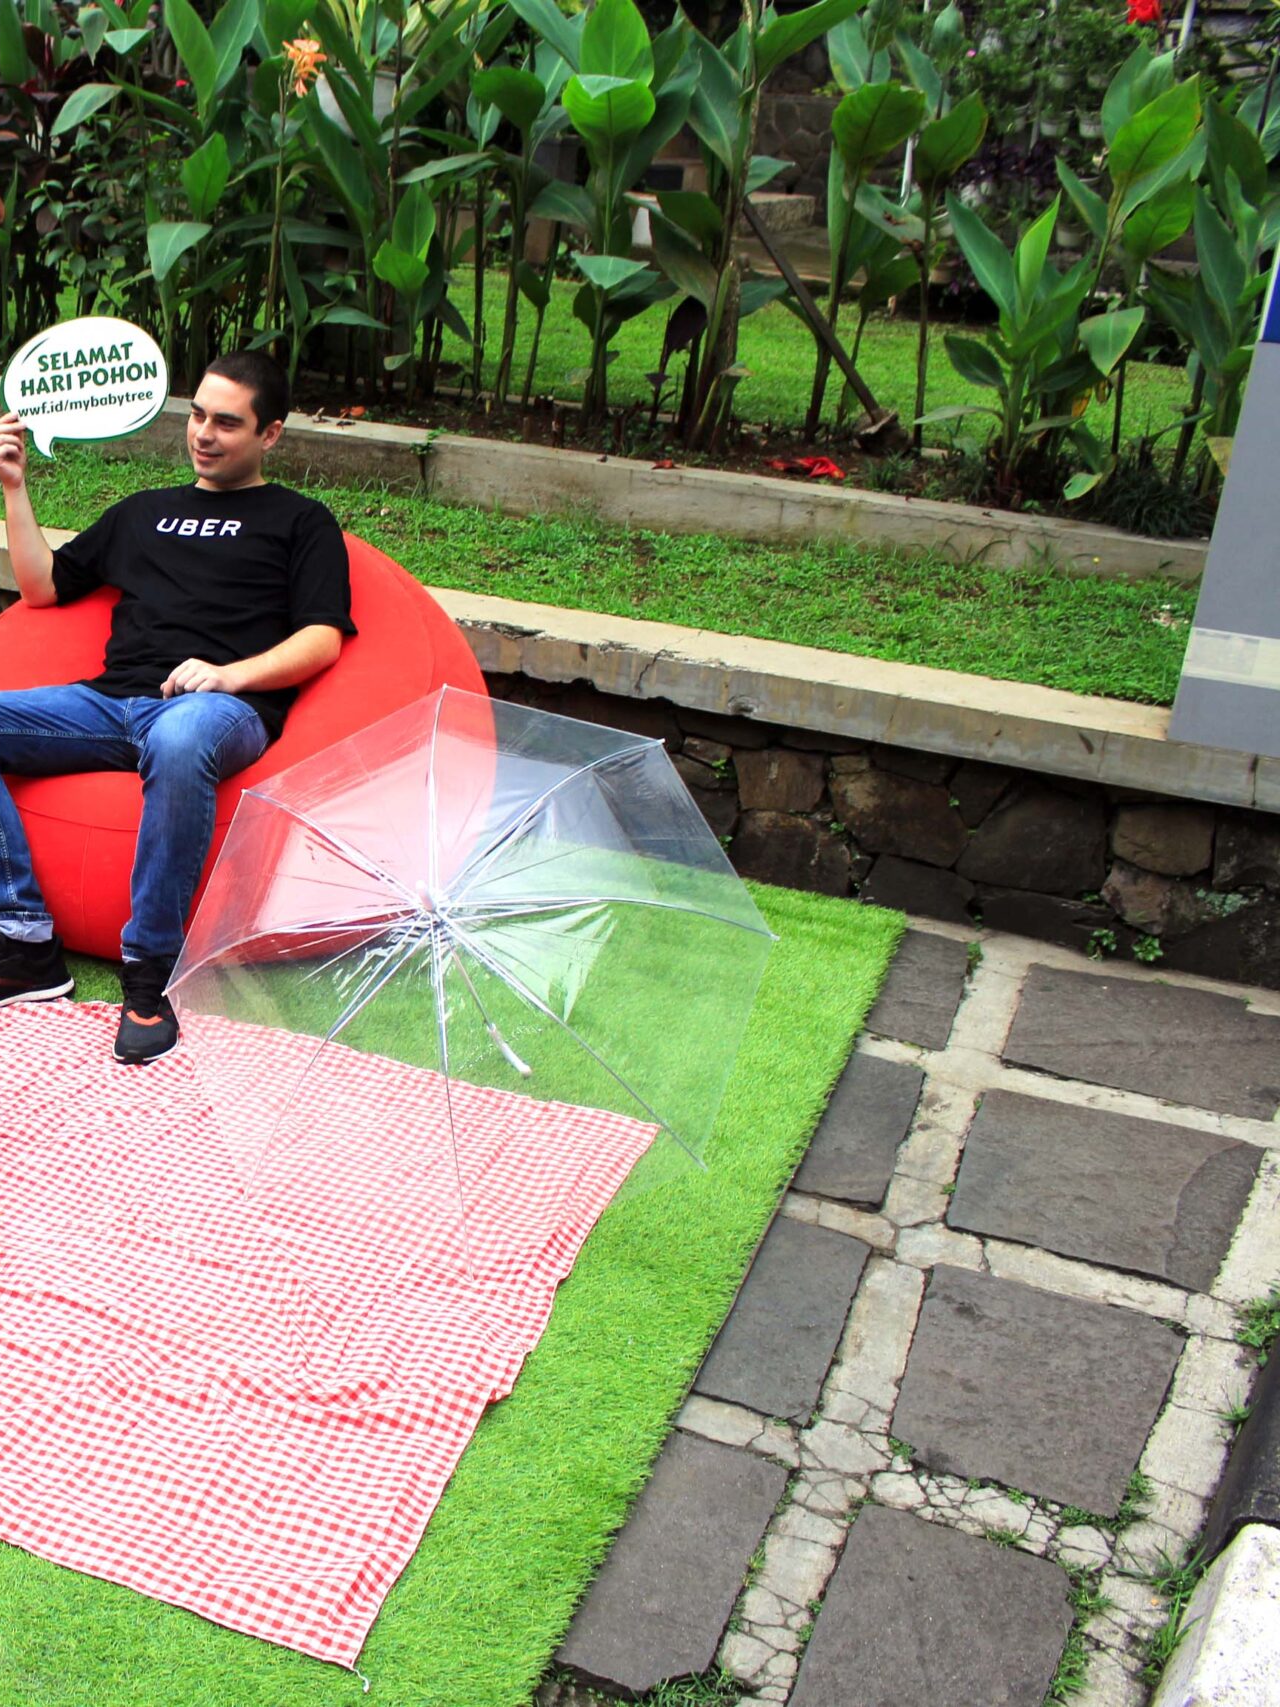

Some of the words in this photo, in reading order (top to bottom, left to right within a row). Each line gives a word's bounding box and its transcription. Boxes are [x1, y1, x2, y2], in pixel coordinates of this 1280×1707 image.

[37, 341, 134, 372] SELAMAT
[20, 372, 71, 397] HARI
[78, 361, 158, 391] POHON
[18, 391, 153, 417] wwf.id/mybabytree
[156, 518, 242, 536] UBER
